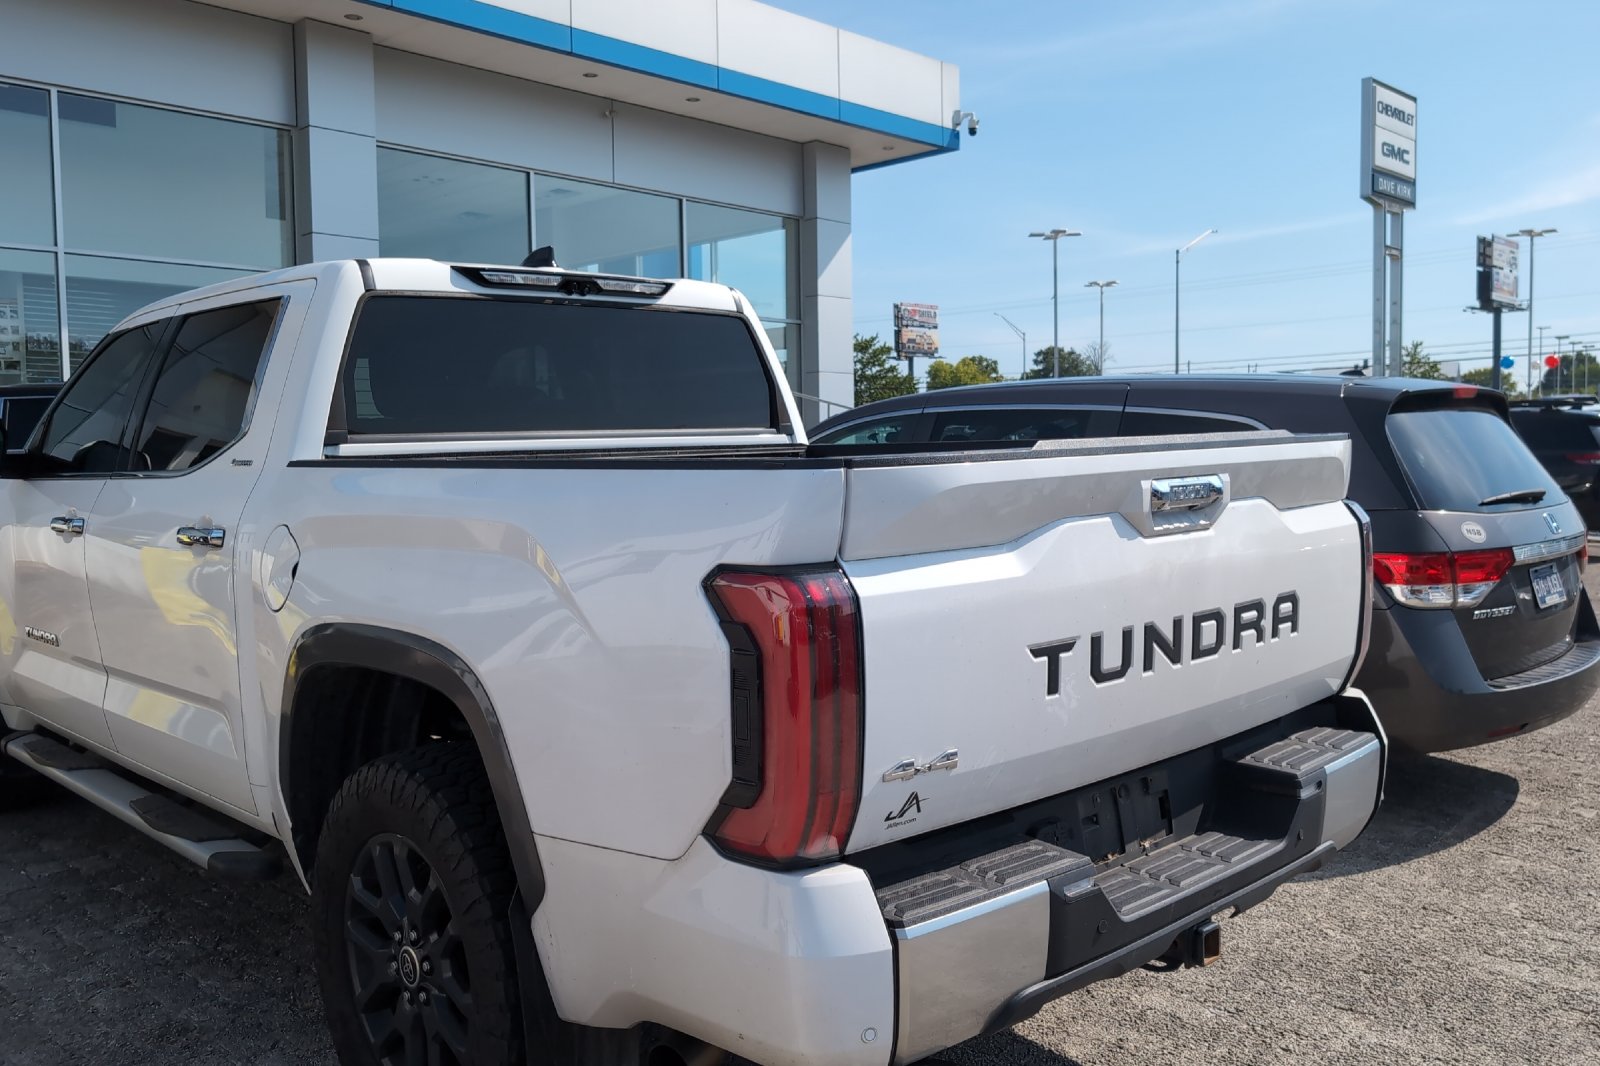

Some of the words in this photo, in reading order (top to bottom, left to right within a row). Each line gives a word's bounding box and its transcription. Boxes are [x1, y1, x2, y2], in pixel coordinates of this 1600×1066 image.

[1377, 100, 1414, 126] CHEVROLET
[1381, 141, 1410, 165] GMC
[1378, 177, 1395, 195] DAVE
[1472, 605, 1516, 620] ODYSSEY
[1026, 589, 1300, 699] TUNDRA
